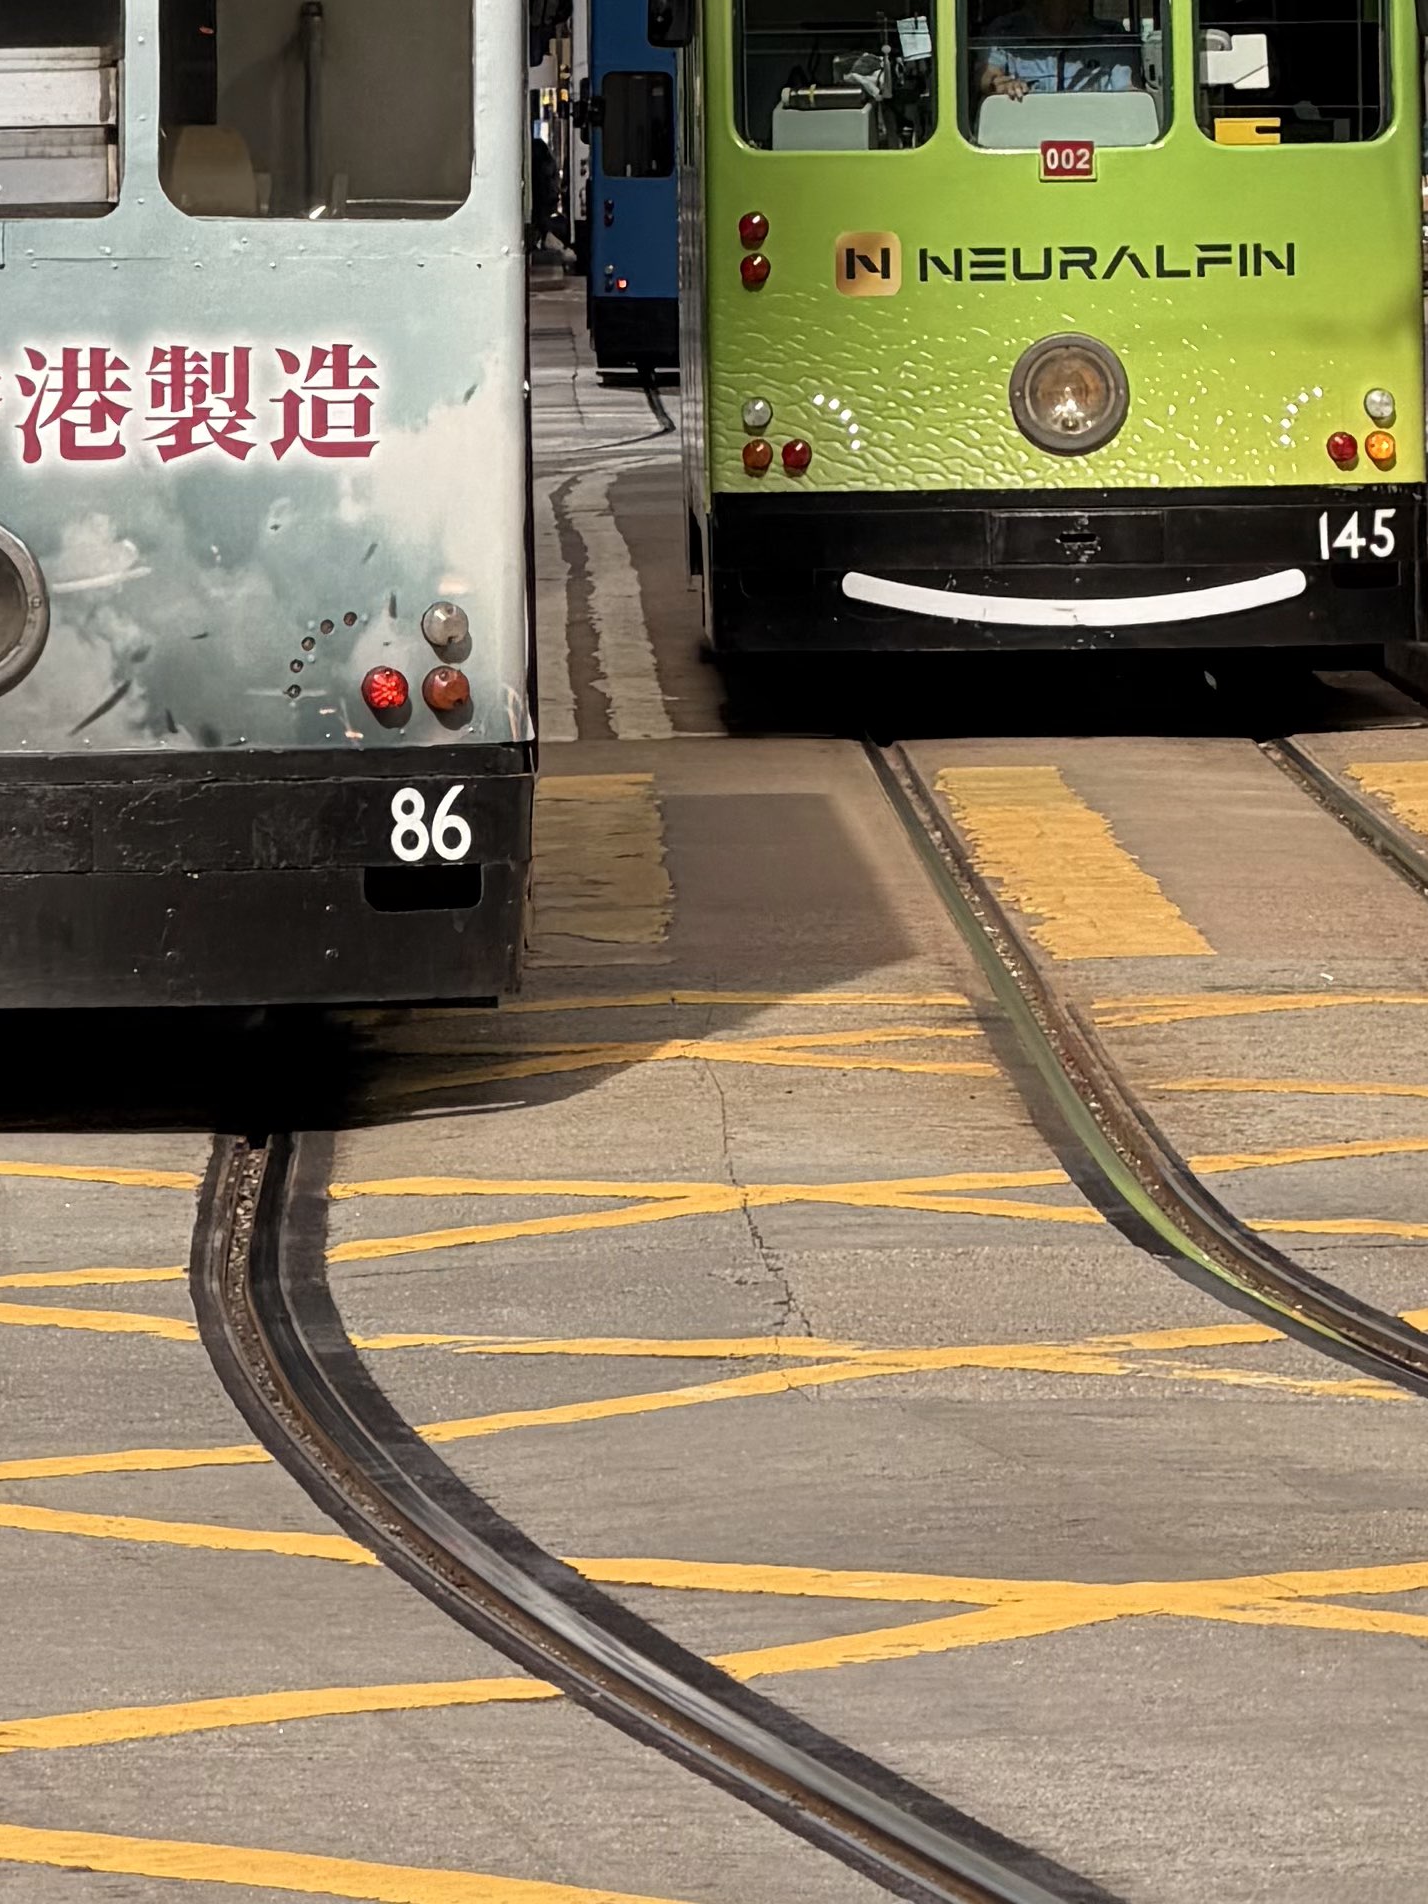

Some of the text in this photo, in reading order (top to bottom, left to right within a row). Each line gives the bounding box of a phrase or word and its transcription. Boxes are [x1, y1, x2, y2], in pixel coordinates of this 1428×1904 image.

[1045, 148, 1091, 172] 002
[918, 242, 1297, 283] NEURALFIN
[1319, 508, 1396, 560] 145
[389, 784, 471, 864] 86
